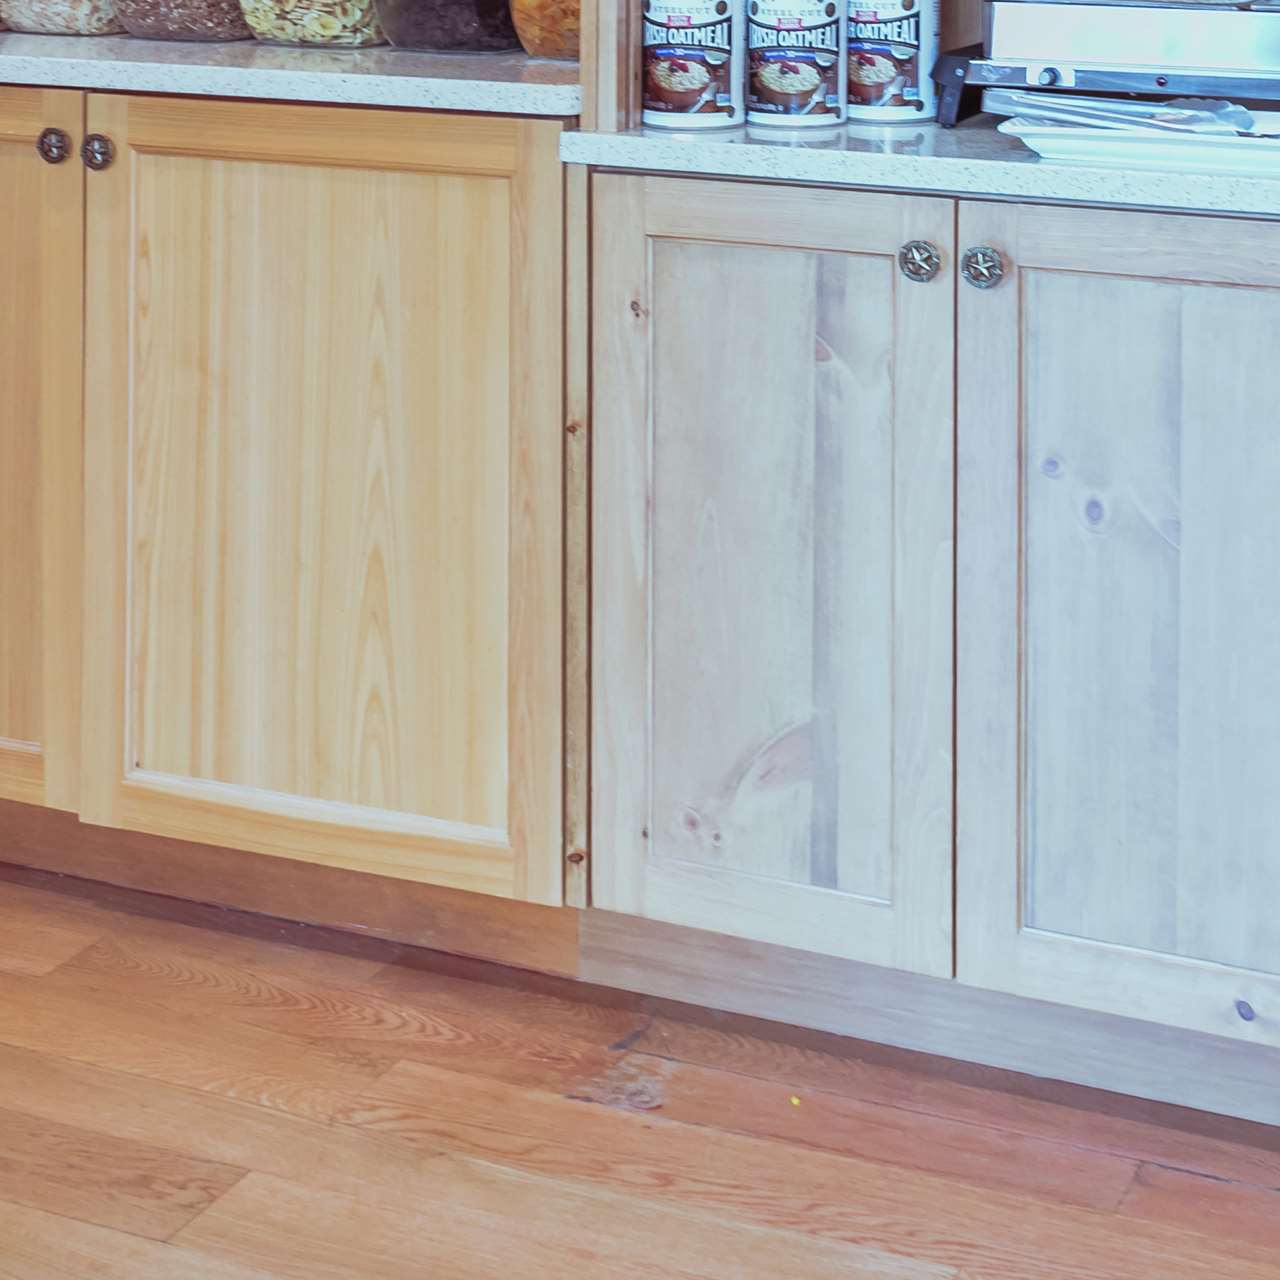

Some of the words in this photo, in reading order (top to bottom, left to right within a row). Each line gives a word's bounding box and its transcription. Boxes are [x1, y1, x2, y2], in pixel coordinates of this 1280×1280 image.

[668, 22, 731, 50] OATMEAL
[778, 23, 839, 52] OATMEAL
[856, 16, 919, 45] OATMEAL
